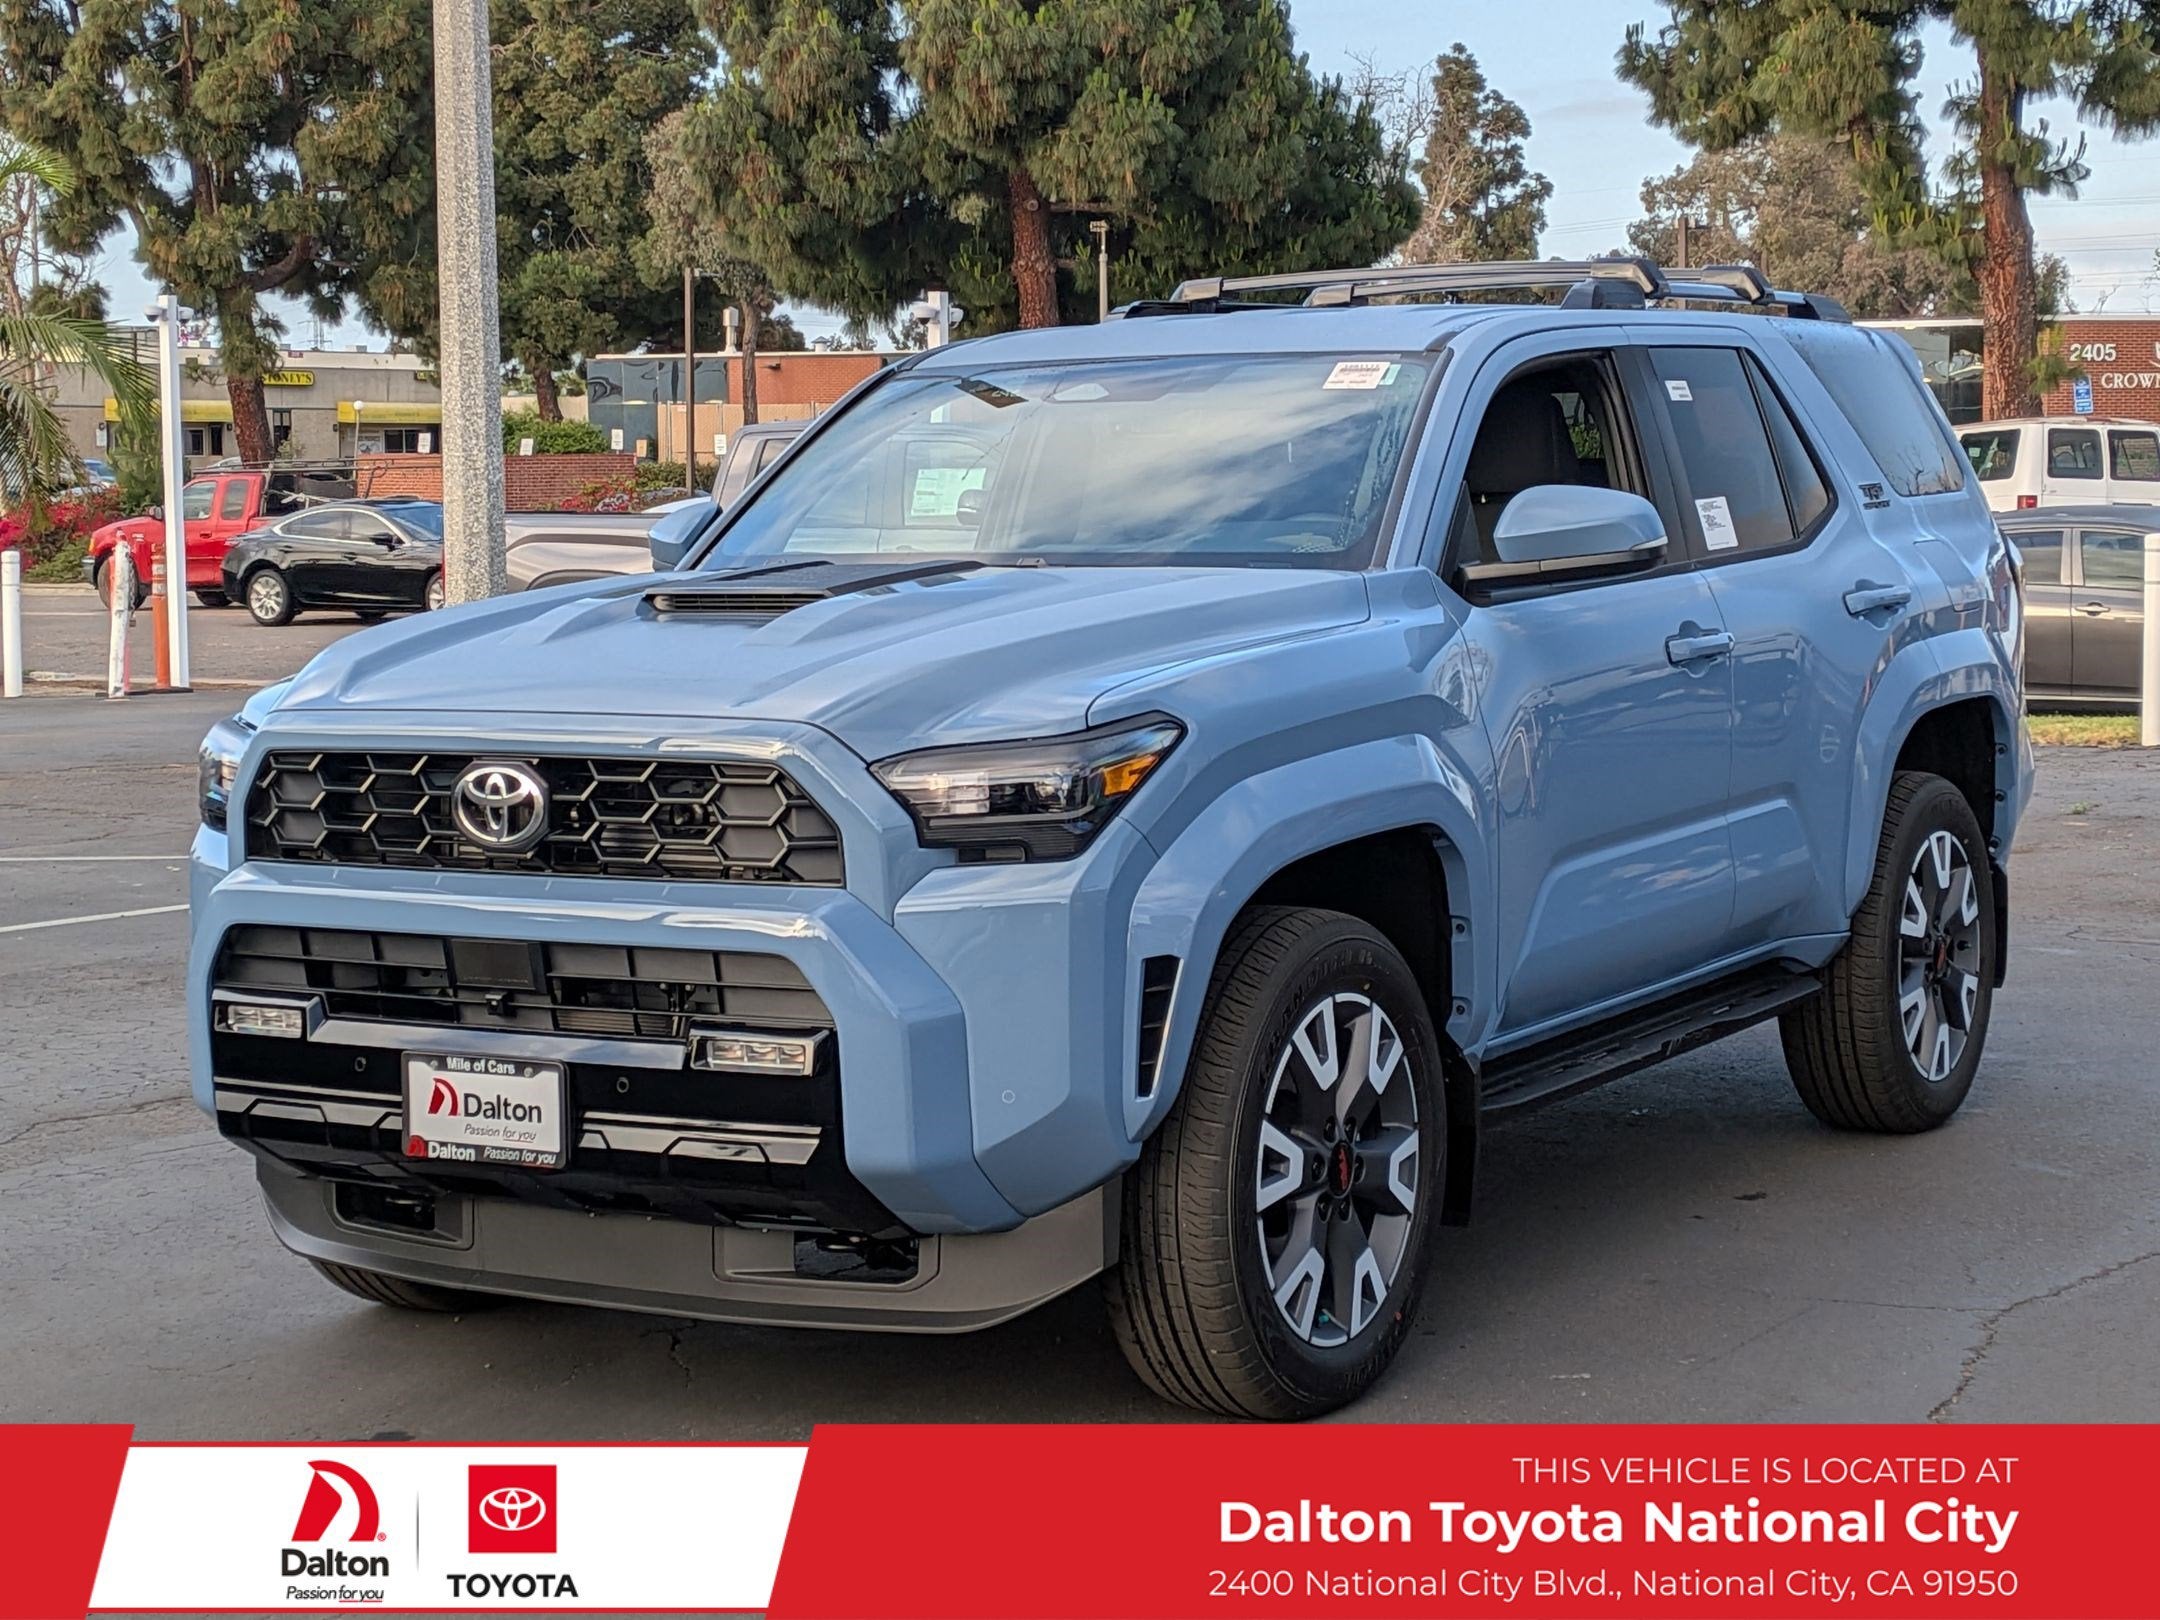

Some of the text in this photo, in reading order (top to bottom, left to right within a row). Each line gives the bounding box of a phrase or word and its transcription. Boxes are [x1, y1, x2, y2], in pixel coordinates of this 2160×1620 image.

[2069, 343, 2117, 362] 2405
[446, 1056, 515, 1075] Mile of Cars
[463, 1092, 542, 1124] Dalton
[464, 1123, 537, 1141] Passion for you
[428, 1141, 556, 1166] Dalton Passion for you
